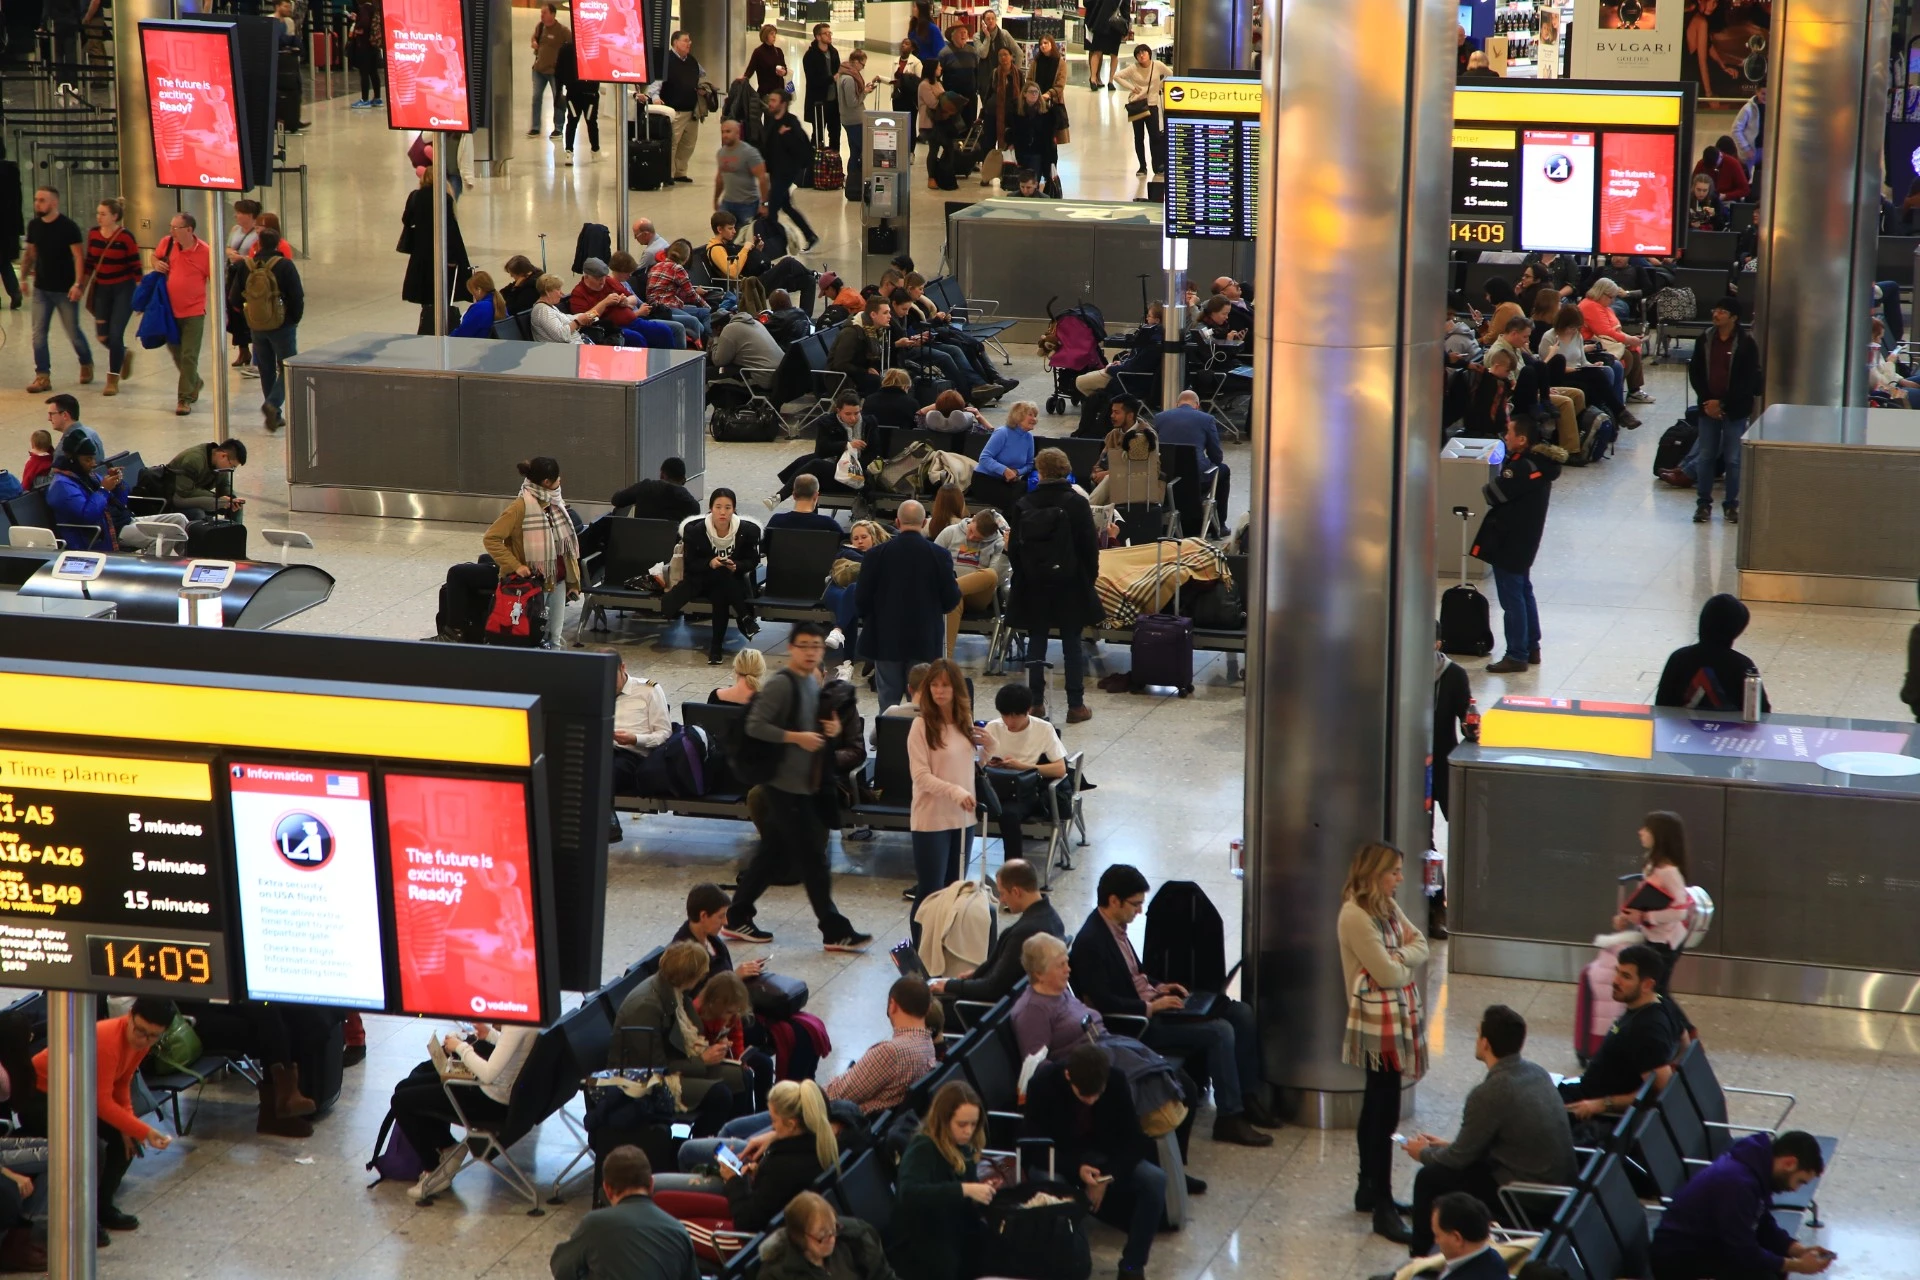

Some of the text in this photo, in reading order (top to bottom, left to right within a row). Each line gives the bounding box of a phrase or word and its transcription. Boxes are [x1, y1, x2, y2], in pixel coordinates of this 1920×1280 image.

[393, 29, 443, 41] The future is
[1596, 42, 1672, 52] BVLGARI
[394, 51, 425, 63] Ready?
[157, 77, 211, 90] The future is
[159, 101, 193, 114] Ready?
[1470, 156, 1509, 168] 5 minutes
[1609, 169, 1656, 179] The future is
[1469, 176, 1509, 188] 5 minutes
[1463, 196, 1508, 207] 15 minutes
[1450, 223, 1504, 243] 14:09
[8, 760, 139, 785] Time planner
[247, 768, 314, 784] Information
[0, 803, 55, 826] 1-A5
[128, 812, 203, 837] 5 minutes
[132, 852, 206, 876] 5 minutes
[405, 847, 493, 869] The future is
[407, 867, 467, 887] exciting.
[258, 878, 323, 892] Extra security
[274, 891, 294, 900] USA
[296, 892, 327, 903] flights
[408, 884, 462, 905] Ready?
[11, 901, 57, 915] walkway
[123, 890, 210, 915] 15 minutes
[35, 928, 66, 940] allow
[43, 940, 69, 952] time
[264, 943, 290, 953] Check
[1, 948, 73, 964] to reach your
[1, 960, 28, 972] gate
[105, 942, 210, 984] 14:09
[487, 1000, 528, 1013] vodafone
